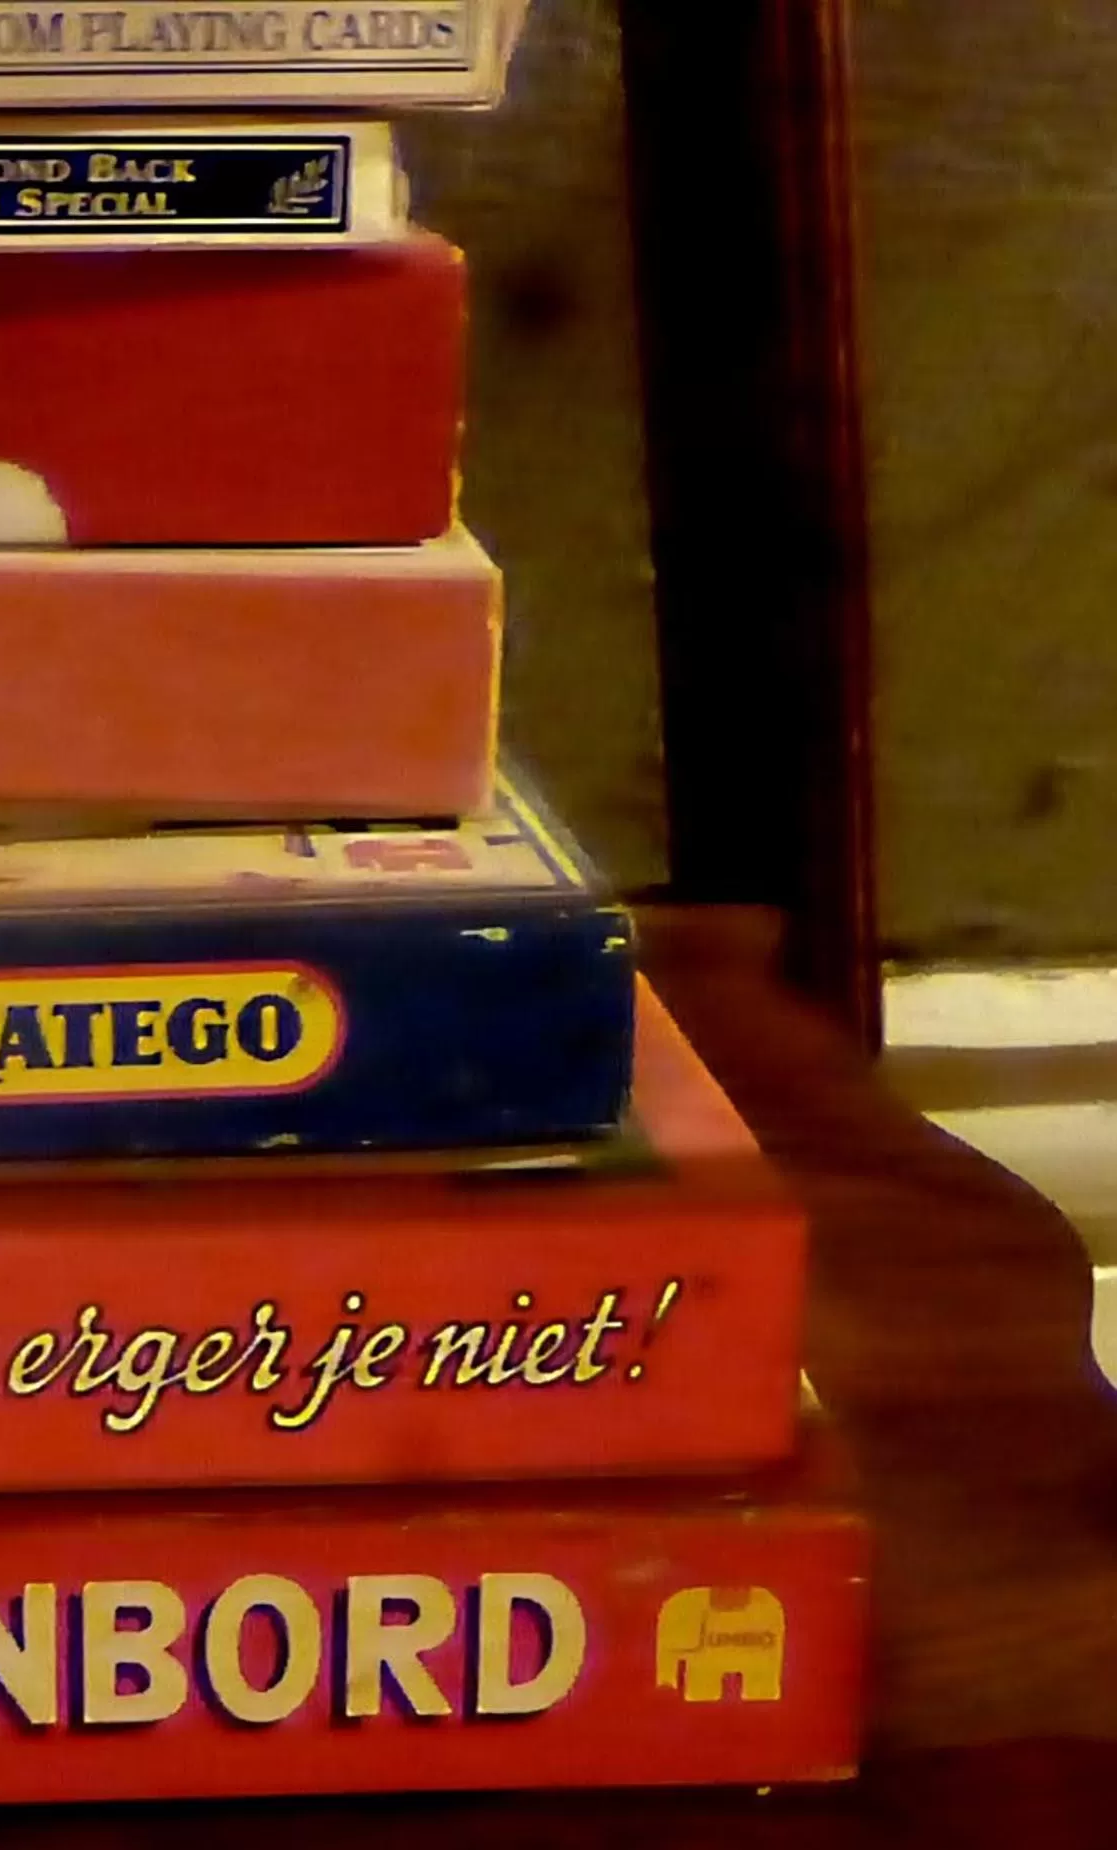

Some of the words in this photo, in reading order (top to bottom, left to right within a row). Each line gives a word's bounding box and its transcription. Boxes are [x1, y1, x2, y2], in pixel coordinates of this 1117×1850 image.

[80, 11, 286, 51] PLAYING
[302, 10, 457, 51] CARDS
[87, 153, 197, 183] BACK
[15, 188, 177, 217] SPECIAL
[8, 1304, 287, 1431] erger
[273, 1294, 405, 1428] je
